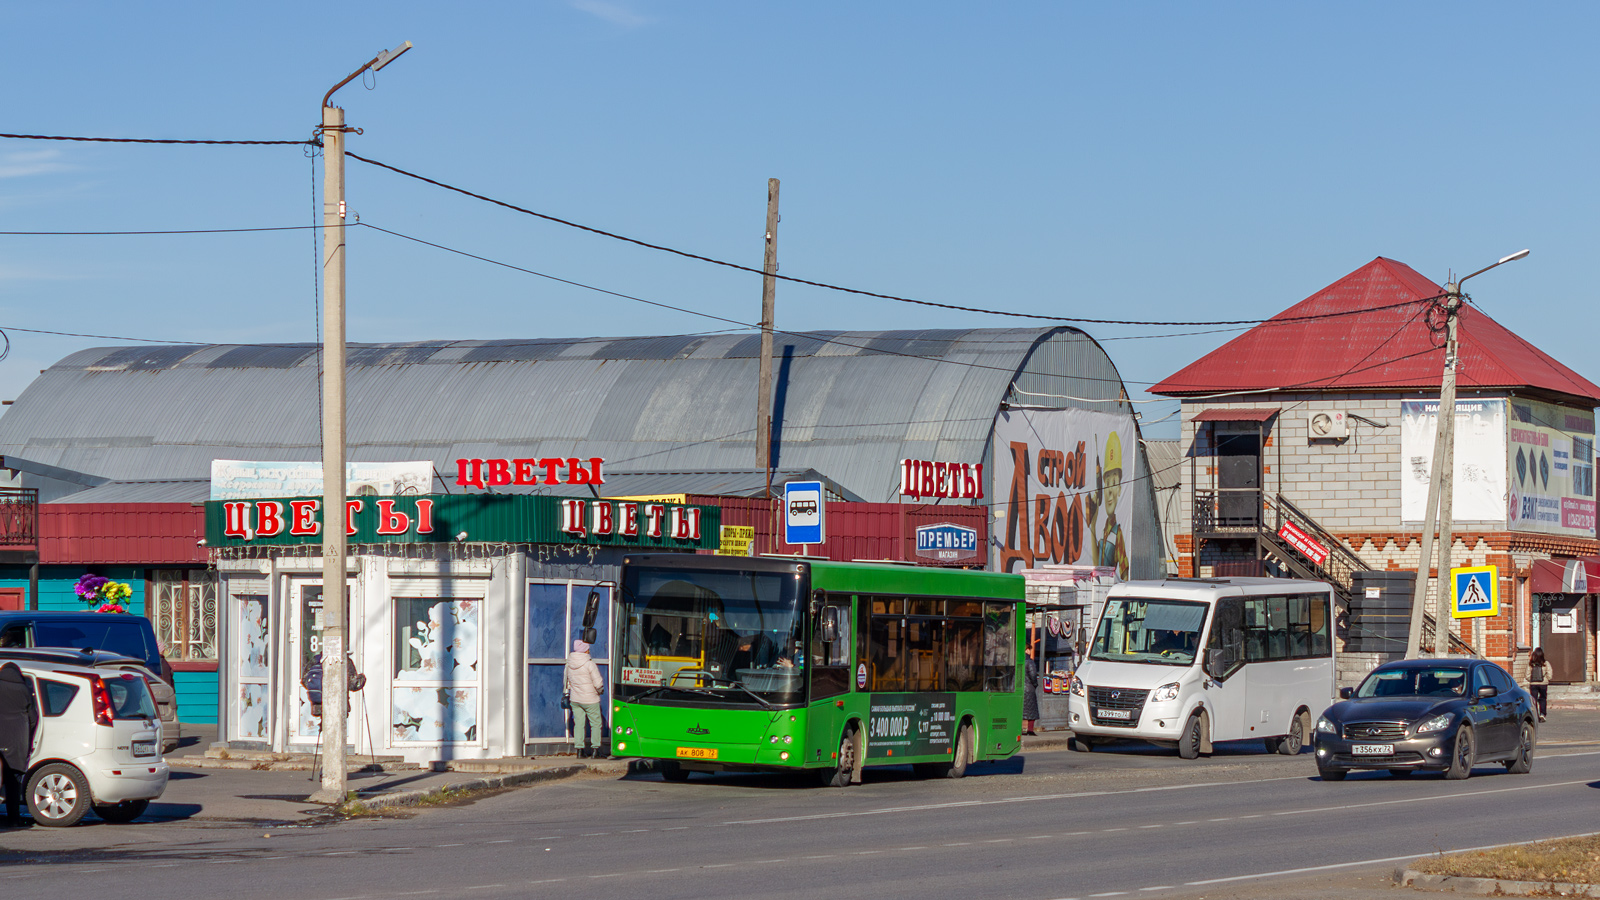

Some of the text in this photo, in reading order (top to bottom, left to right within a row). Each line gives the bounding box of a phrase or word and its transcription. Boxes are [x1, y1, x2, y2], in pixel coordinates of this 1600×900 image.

[1424, 403, 1483, 413] НАСЯЩИЕ
[456, 457, 605, 489] ЦВЕТЫ
[1038, 441, 1086, 489] СТРОЙ
[900, 458, 984, 502] ЦВЕТЫ
[224, 499, 434, 541] ЦВЕТЫ
[561, 499, 700, 539] ЦВЕТЫ
[919, 531, 975, 548] ПРЕМЬЕР
[938, 550, 958, 559] МАГАЗИН
[870, 718, 875, 737] 3
[876, 718, 889, 737] 400
[690, 749, 705, 757] 808
